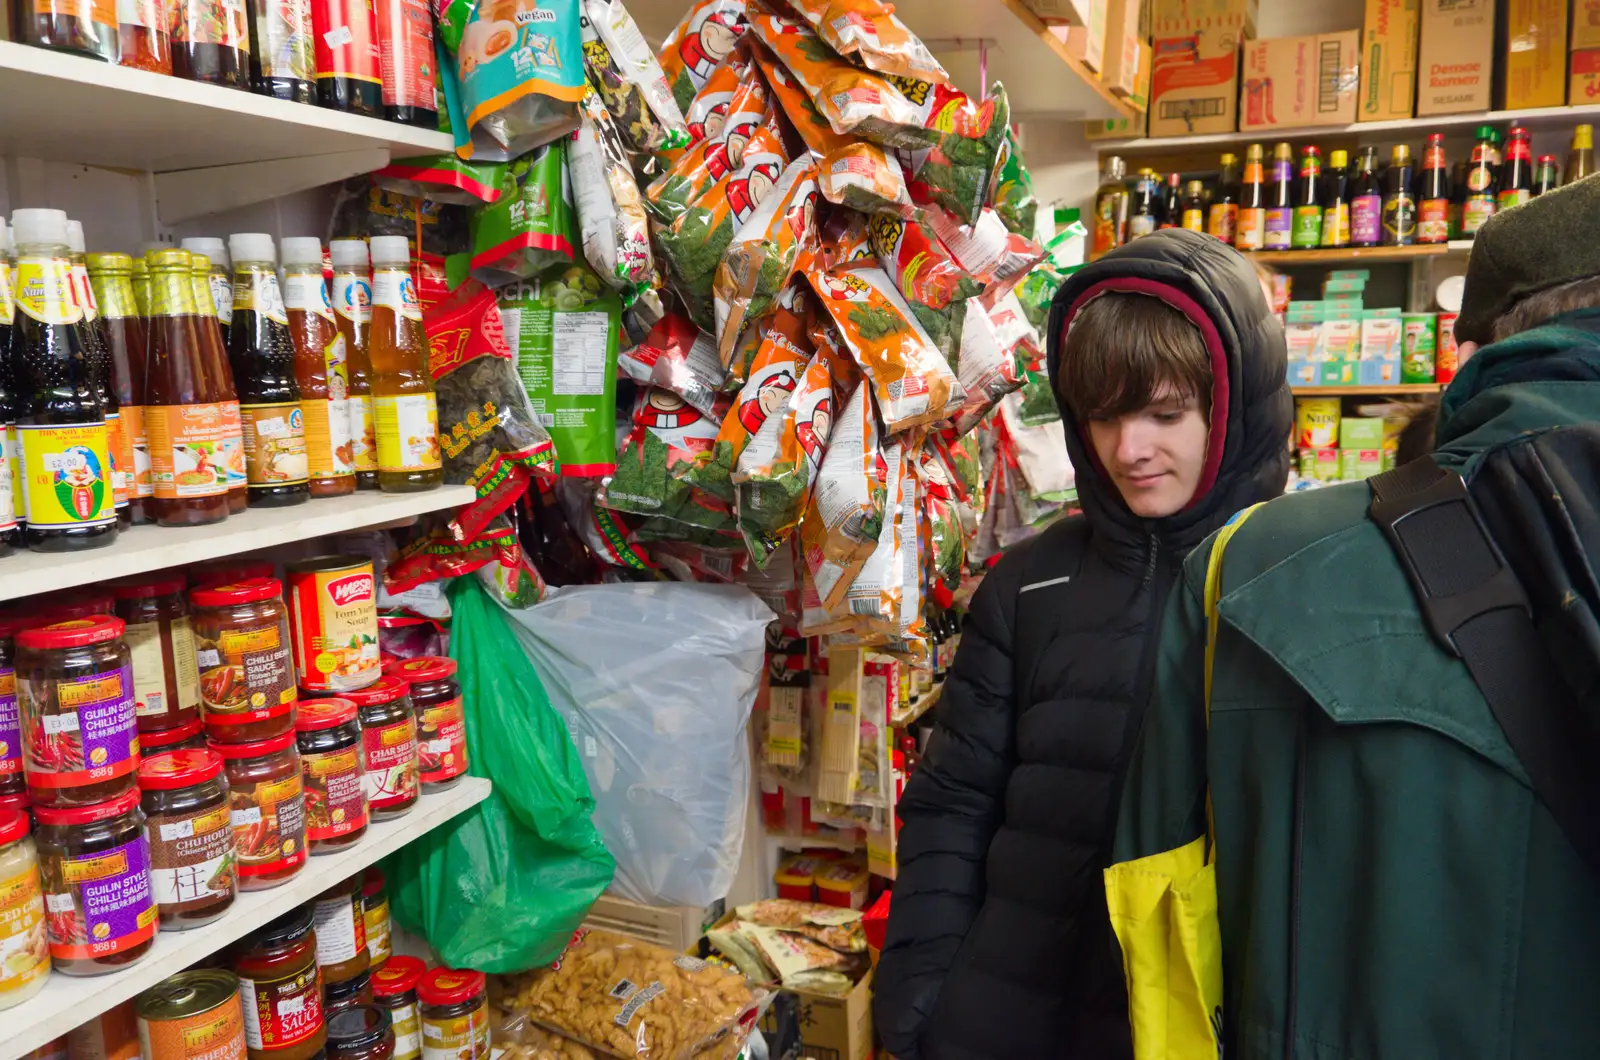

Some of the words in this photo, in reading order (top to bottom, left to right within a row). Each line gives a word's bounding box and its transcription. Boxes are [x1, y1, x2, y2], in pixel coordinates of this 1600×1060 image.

[510, 46, 532, 67] 12
[509, 200, 526, 219] 12
[247, 661, 276, 674] SAUCE
[85, 705, 118, 721] GUILIN
[86, 716, 117, 731] CHILLI
[90, 768, 106, 778] 368
[176, 836, 201, 850] CHU
[87, 881, 121, 897] GUILIN
[123, 869, 147, 888] STYLE
[88, 891, 121, 907] CHILLI
[122, 879, 149, 898] SAUCE
[92, 942, 109, 953] 368
[277, 982, 297, 994] TIGER
[281, 1005, 319, 1033] SAUCE
